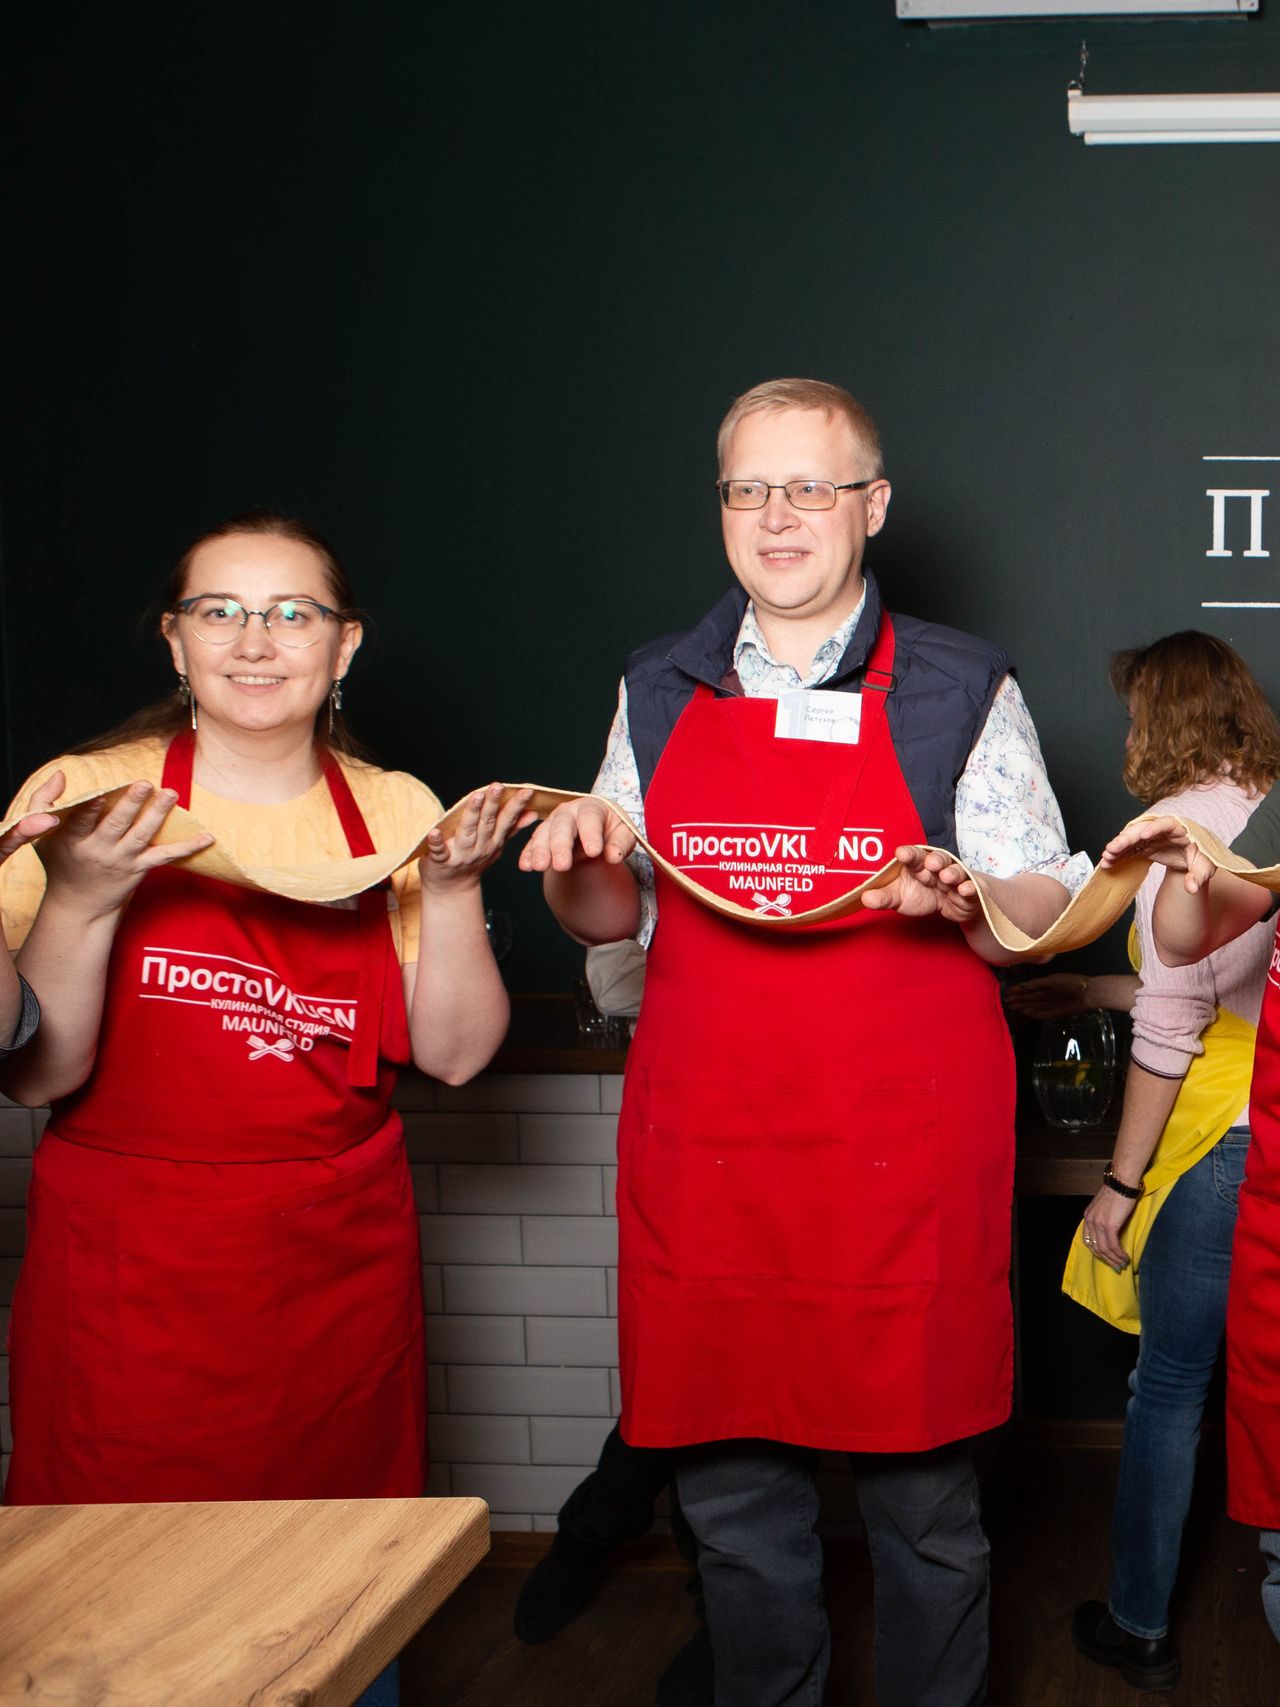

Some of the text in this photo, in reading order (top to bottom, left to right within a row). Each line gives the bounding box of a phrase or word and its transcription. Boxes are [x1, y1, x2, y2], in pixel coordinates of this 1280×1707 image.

[672, 831, 883, 862] ПростоVKNO
[718, 861, 826, 876] КУЛИНАРНАЯ СТУДИЯ
[729, 875, 814, 892] MAUNFELD
[141, 956, 356, 1031] ПростоVKUSN
[210, 998, 331, 1036] КУЛИНАРНАЯ СТУДИЯ
